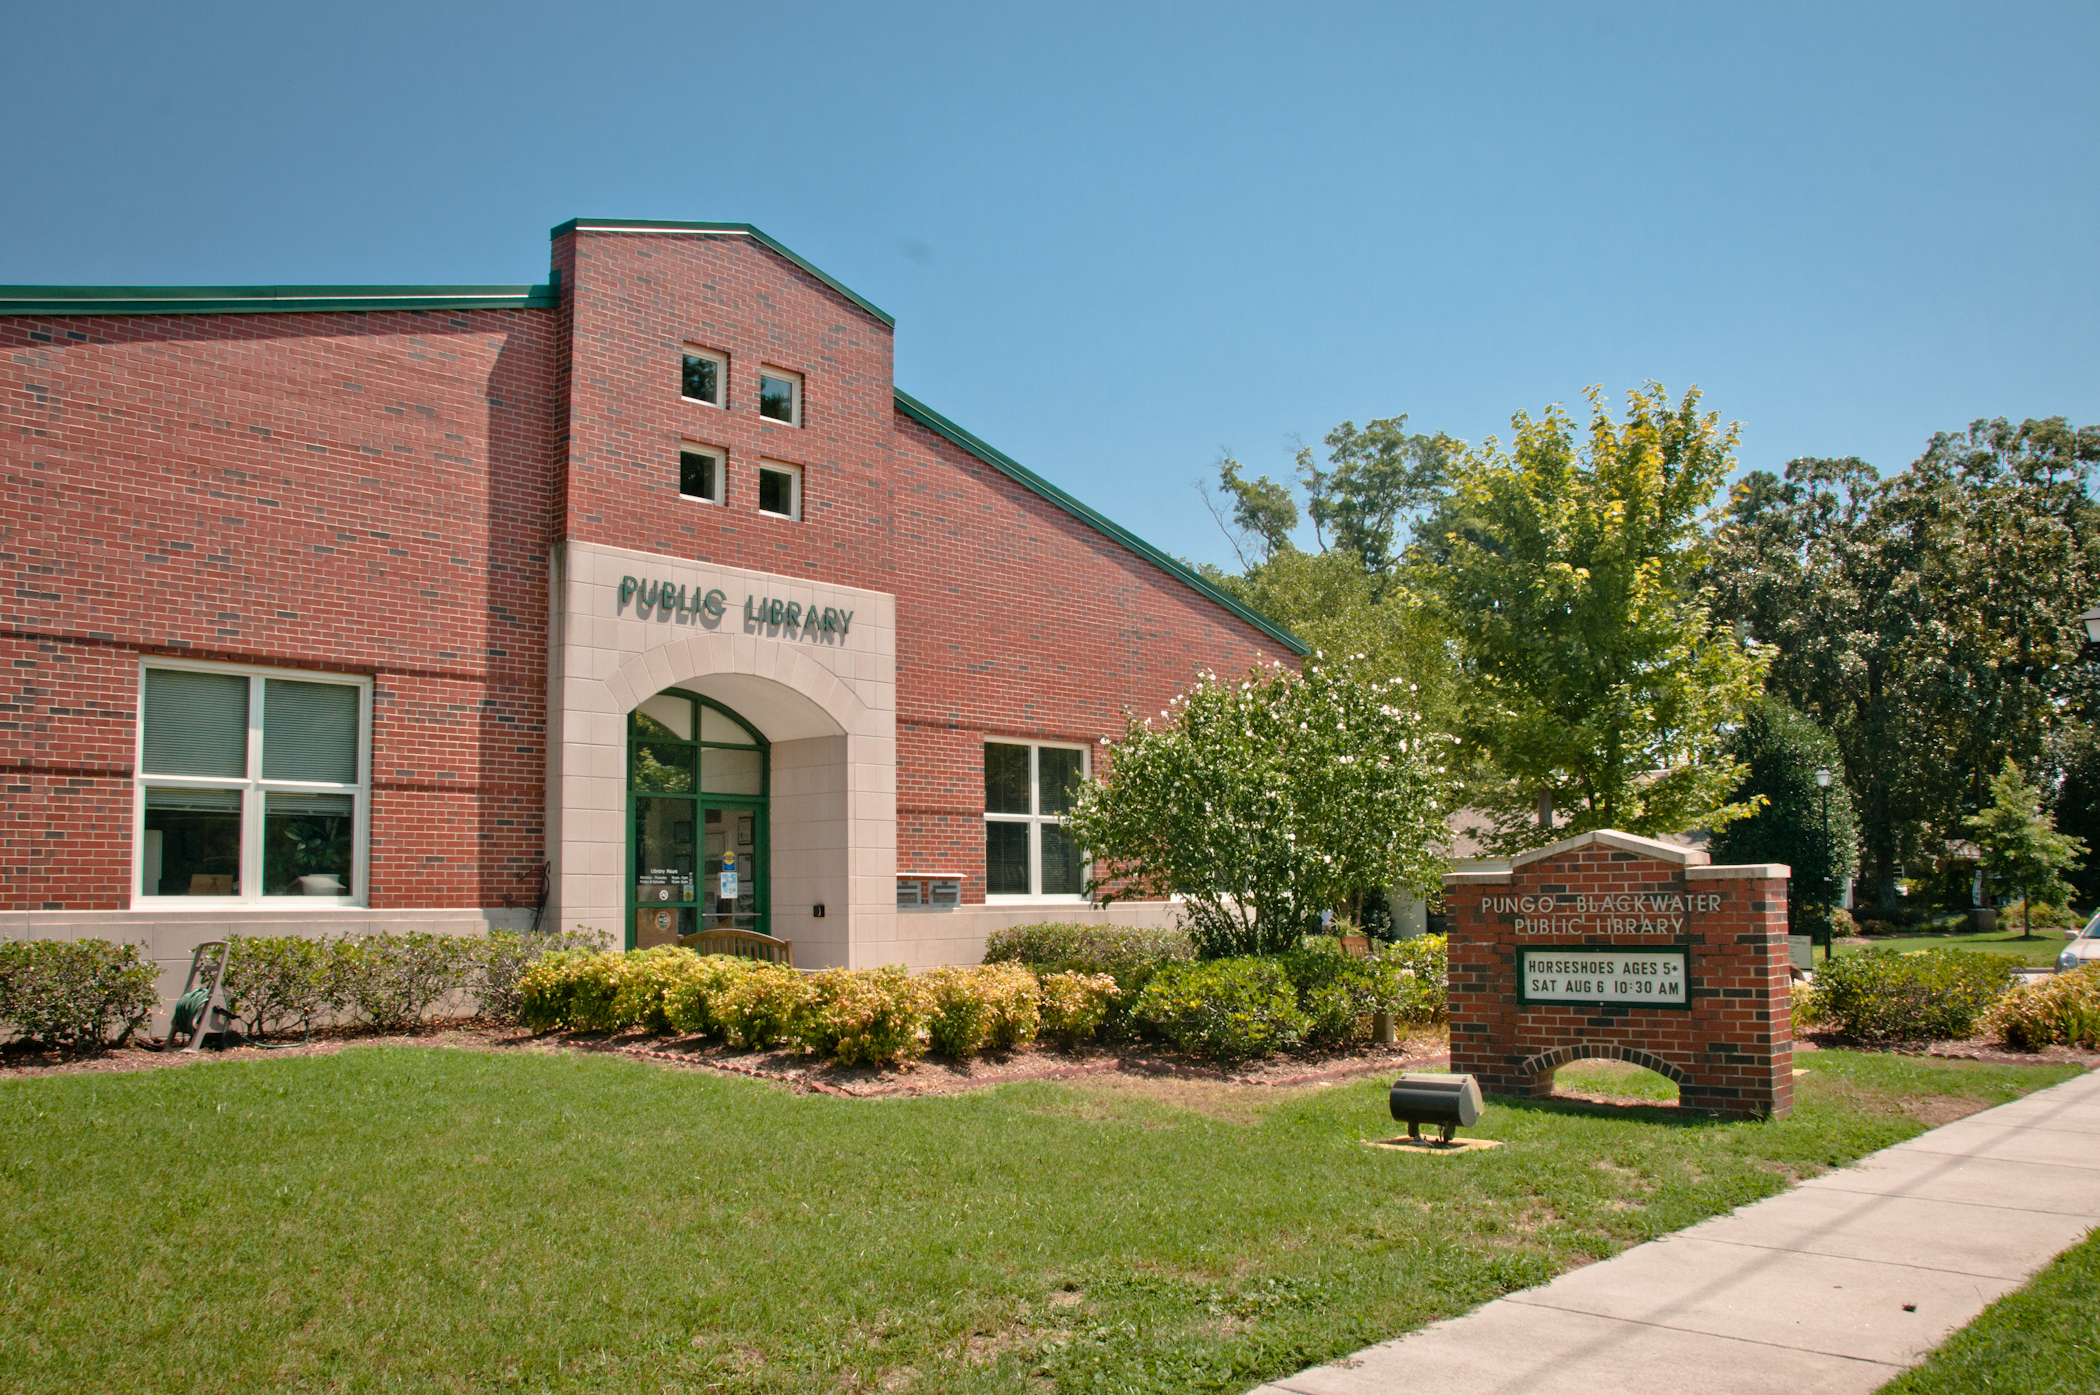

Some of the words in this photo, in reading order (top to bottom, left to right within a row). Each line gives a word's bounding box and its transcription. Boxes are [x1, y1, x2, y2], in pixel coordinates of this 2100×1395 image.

[623, 575, 727, 616] PUBLIC
[748, 594, 854, 634] LIBRARY
[1482, 896, 1554, 914] PUNGO
[1577, 894, 1721, 913] BLACKWATER
[1515, 918, 1583, 935] PUBLIC
[1597, 918, 1684, 935] LIBRARY
[1528, 960, 1614, 975] HORSESHOES
[1622, 961, 1657, 975] AGES
[1663, 962, 1679, 975] 5+
[1532, 979, 1557, 992] SAT
[1565, 980, 1591, 993] AUG
[1597, 980, 1604, 993] 6
[1614, 980, 1652, 994] 10:30
[1658, 981, 1679, 995] AM
